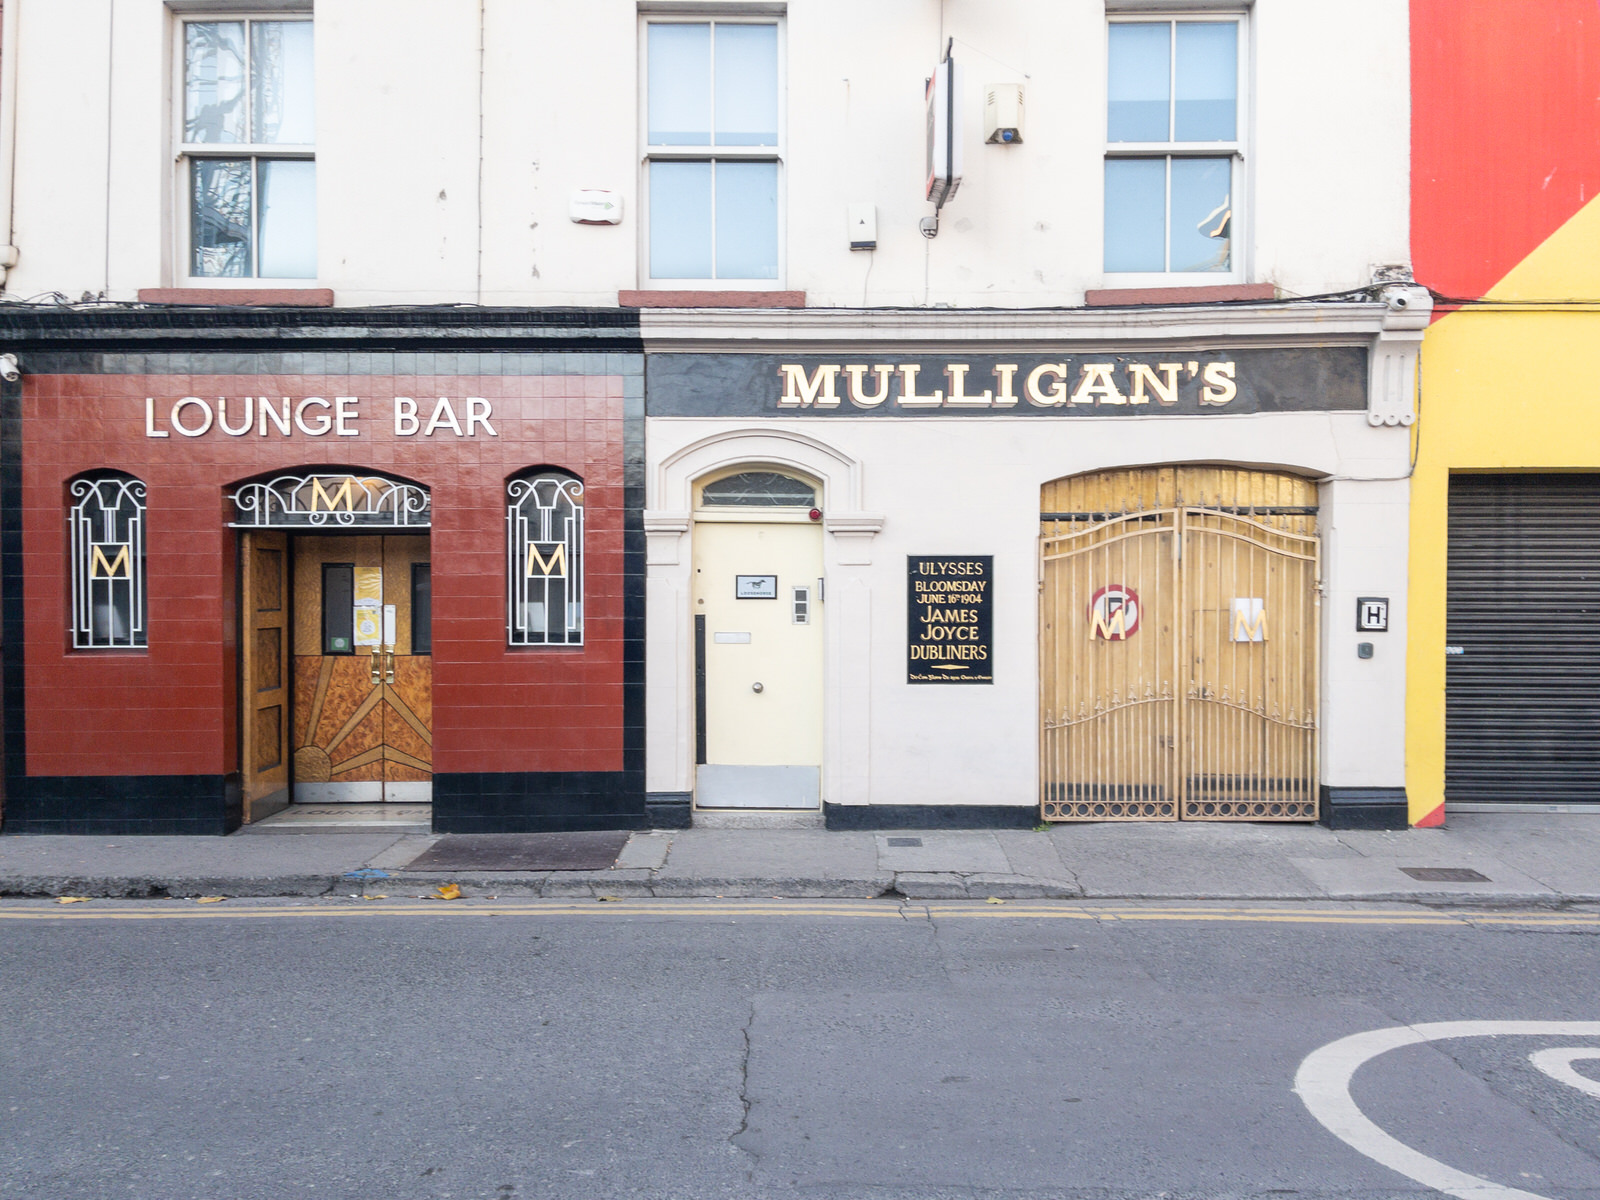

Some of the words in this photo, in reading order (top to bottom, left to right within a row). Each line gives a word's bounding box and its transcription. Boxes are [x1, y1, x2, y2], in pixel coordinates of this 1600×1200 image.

[777, 361, 1239, 408] MULLIGAN'S
[145, 396, 360, 438] LOUNGE
[394, 396, 498, 438] BAR
[91, 544, 131, 578] M
[527, 543, 566, 576] M
[919, 562, 984, 575] ULYSSES
[915, 580, 987, 592] BLOOMSDAY
[916, 593, 946, 604] JUNE
[961, 593, 983, 605] 1904
[920, 605, 979, 623] JAMES
[920, 623, 980, 640] JOYCE
[910, 644, 988, 660] DUBLINERS
